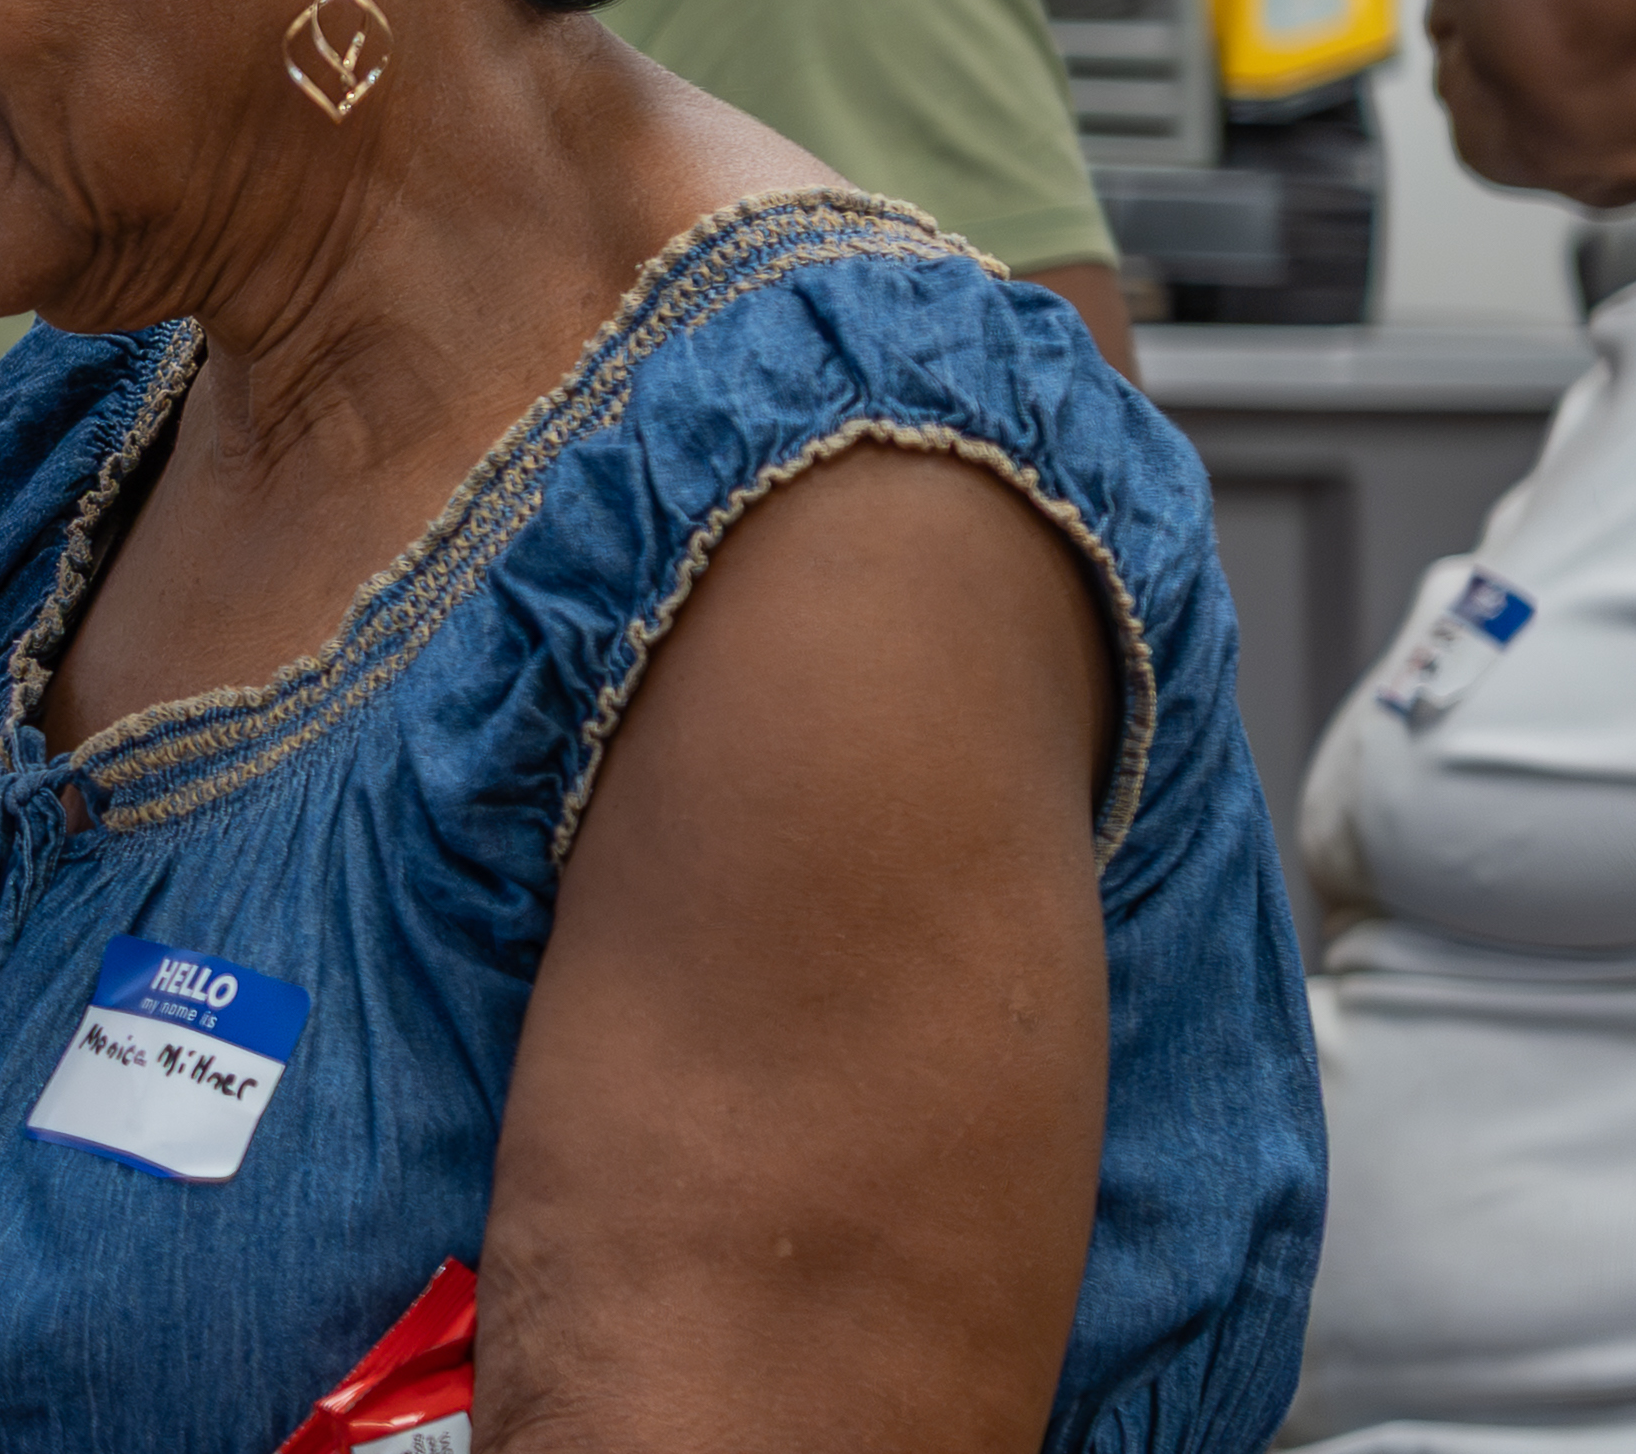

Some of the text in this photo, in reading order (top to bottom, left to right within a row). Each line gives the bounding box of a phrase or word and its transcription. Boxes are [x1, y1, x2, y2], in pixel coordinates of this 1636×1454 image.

[151, 958, 238, 1009] HELLO
[141, 997, 159, 1015] my
[160, 1001, 198, 1022] name
